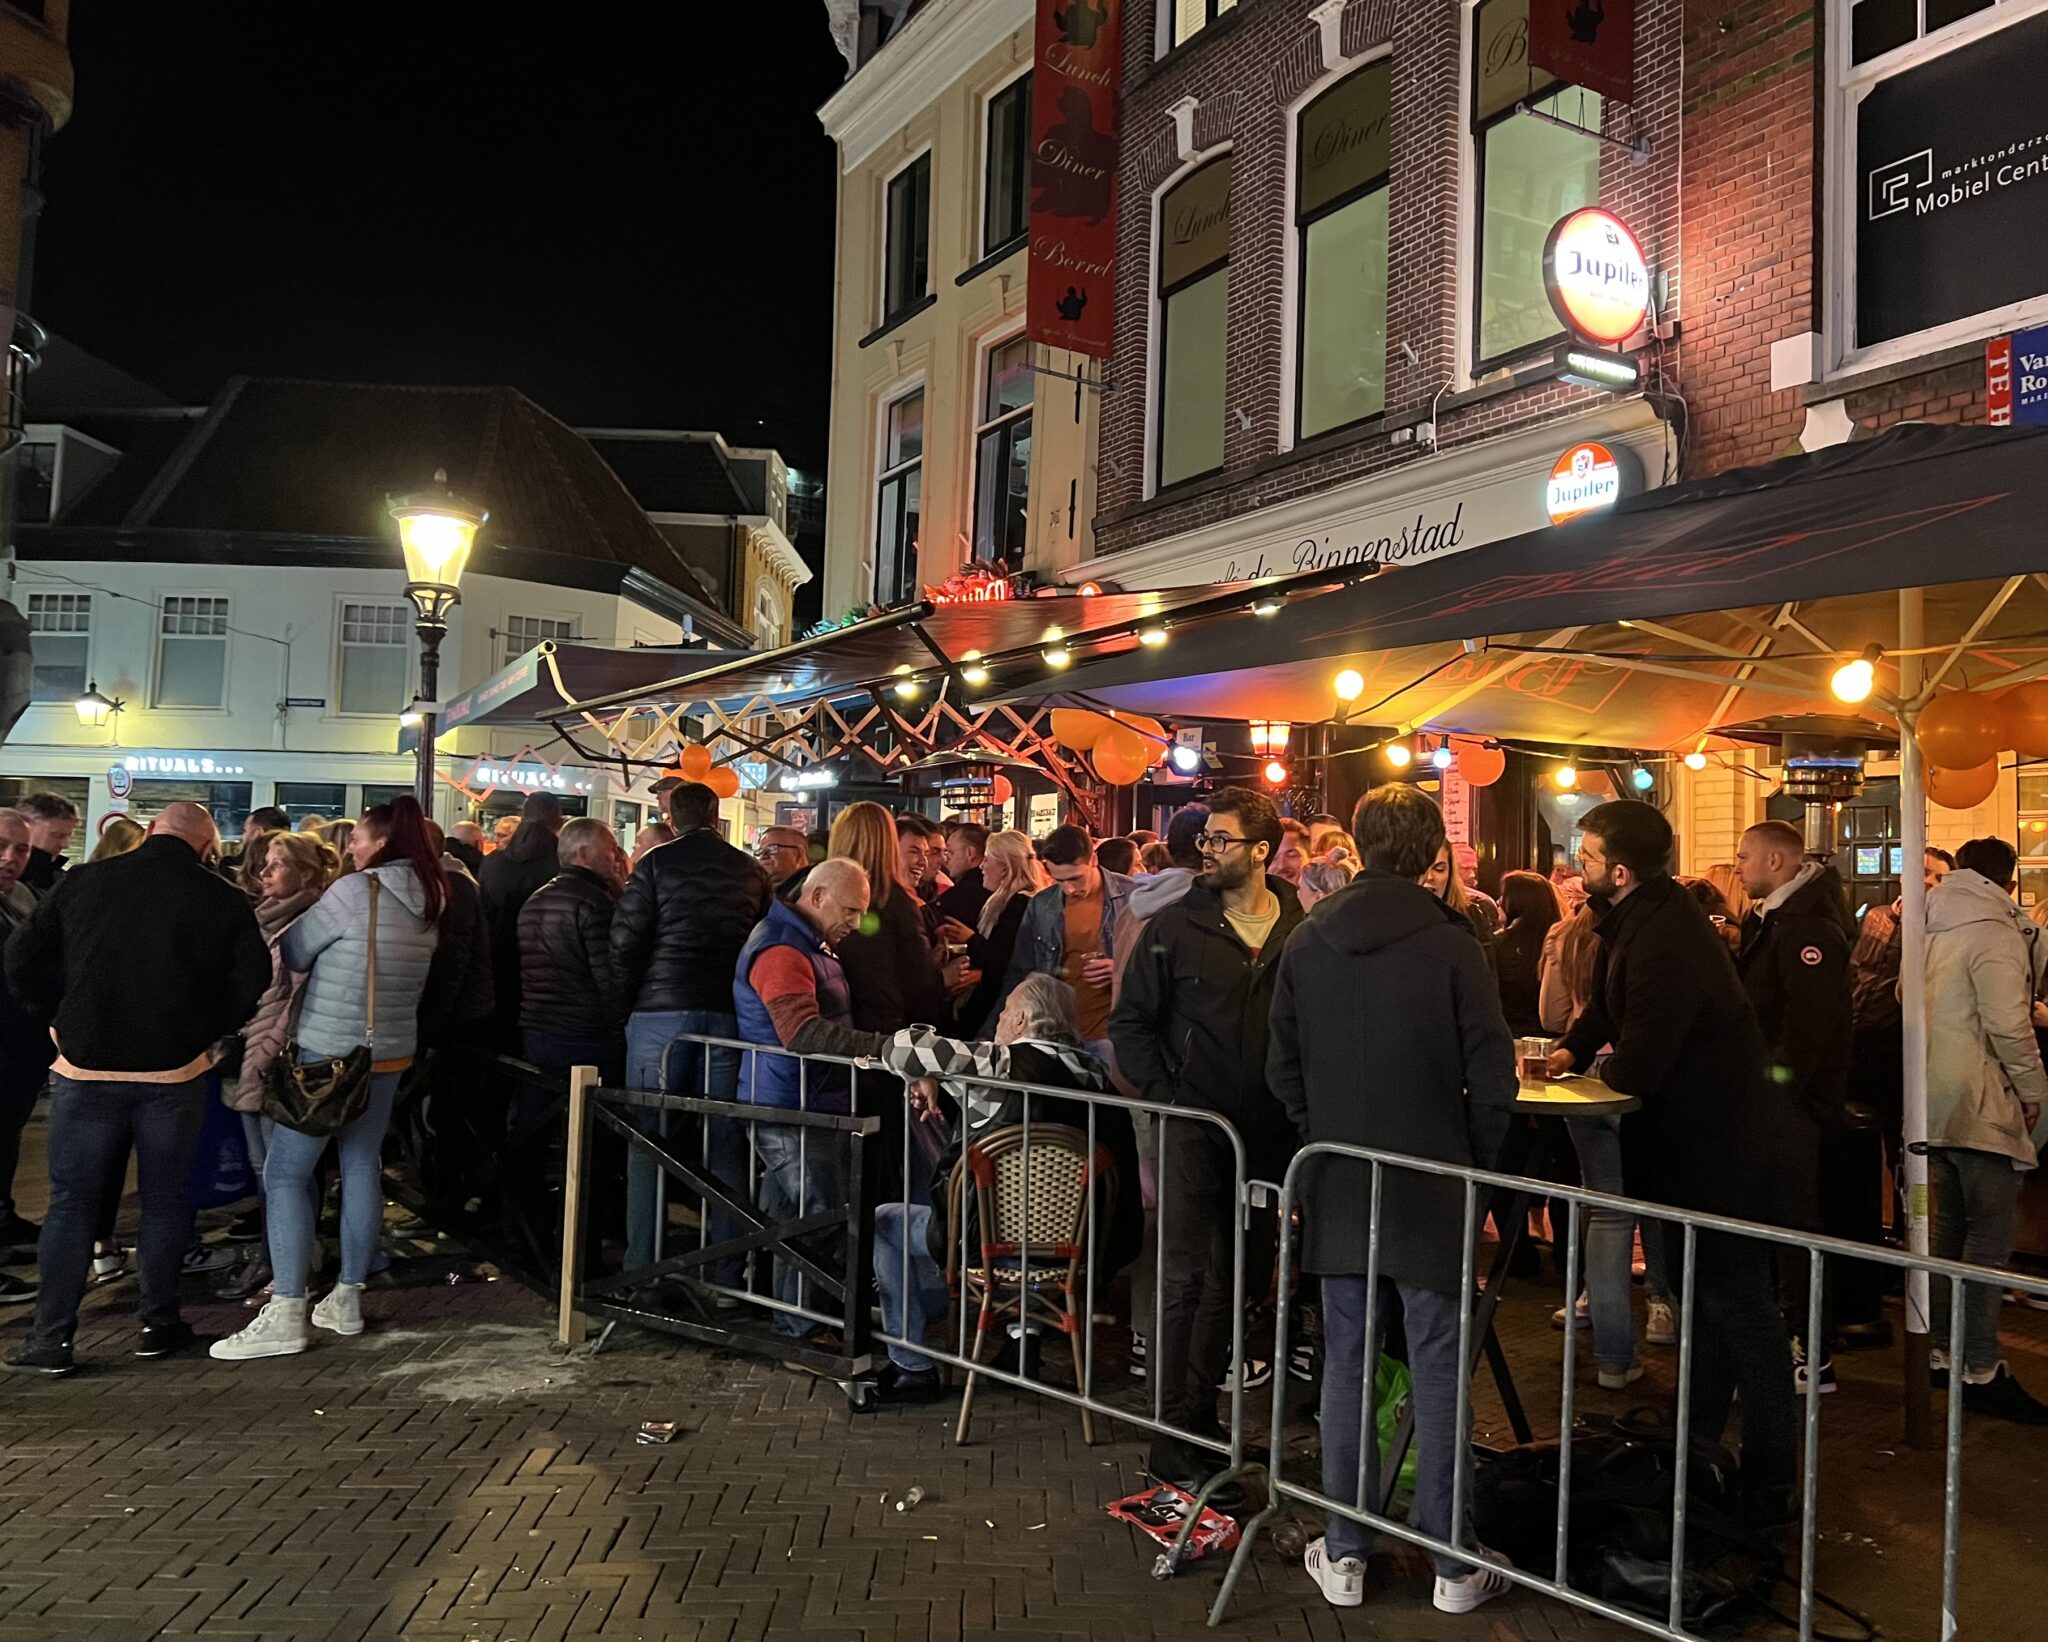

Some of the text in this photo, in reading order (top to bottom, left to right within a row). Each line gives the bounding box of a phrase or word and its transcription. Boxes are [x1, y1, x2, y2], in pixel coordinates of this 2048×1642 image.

[1043, 43, 1111, 88] Lunch
[1038, 138, 1106, 181] Diner
[1311, 113, 1388, 171] Diner
[1916, 154, 2048, 216] Mobiel Cent
[1173, 188, 1232, 245] Lunch
[1033, 236, 1114, 277] Borrel
[1568, 250, 1644, 290] Jupiler
[1554, 480, 1614, 504] Jupiler
[1292, 502, 1464, 573] Binnenstad
[125, 756, 244, 774] RITUALS...
